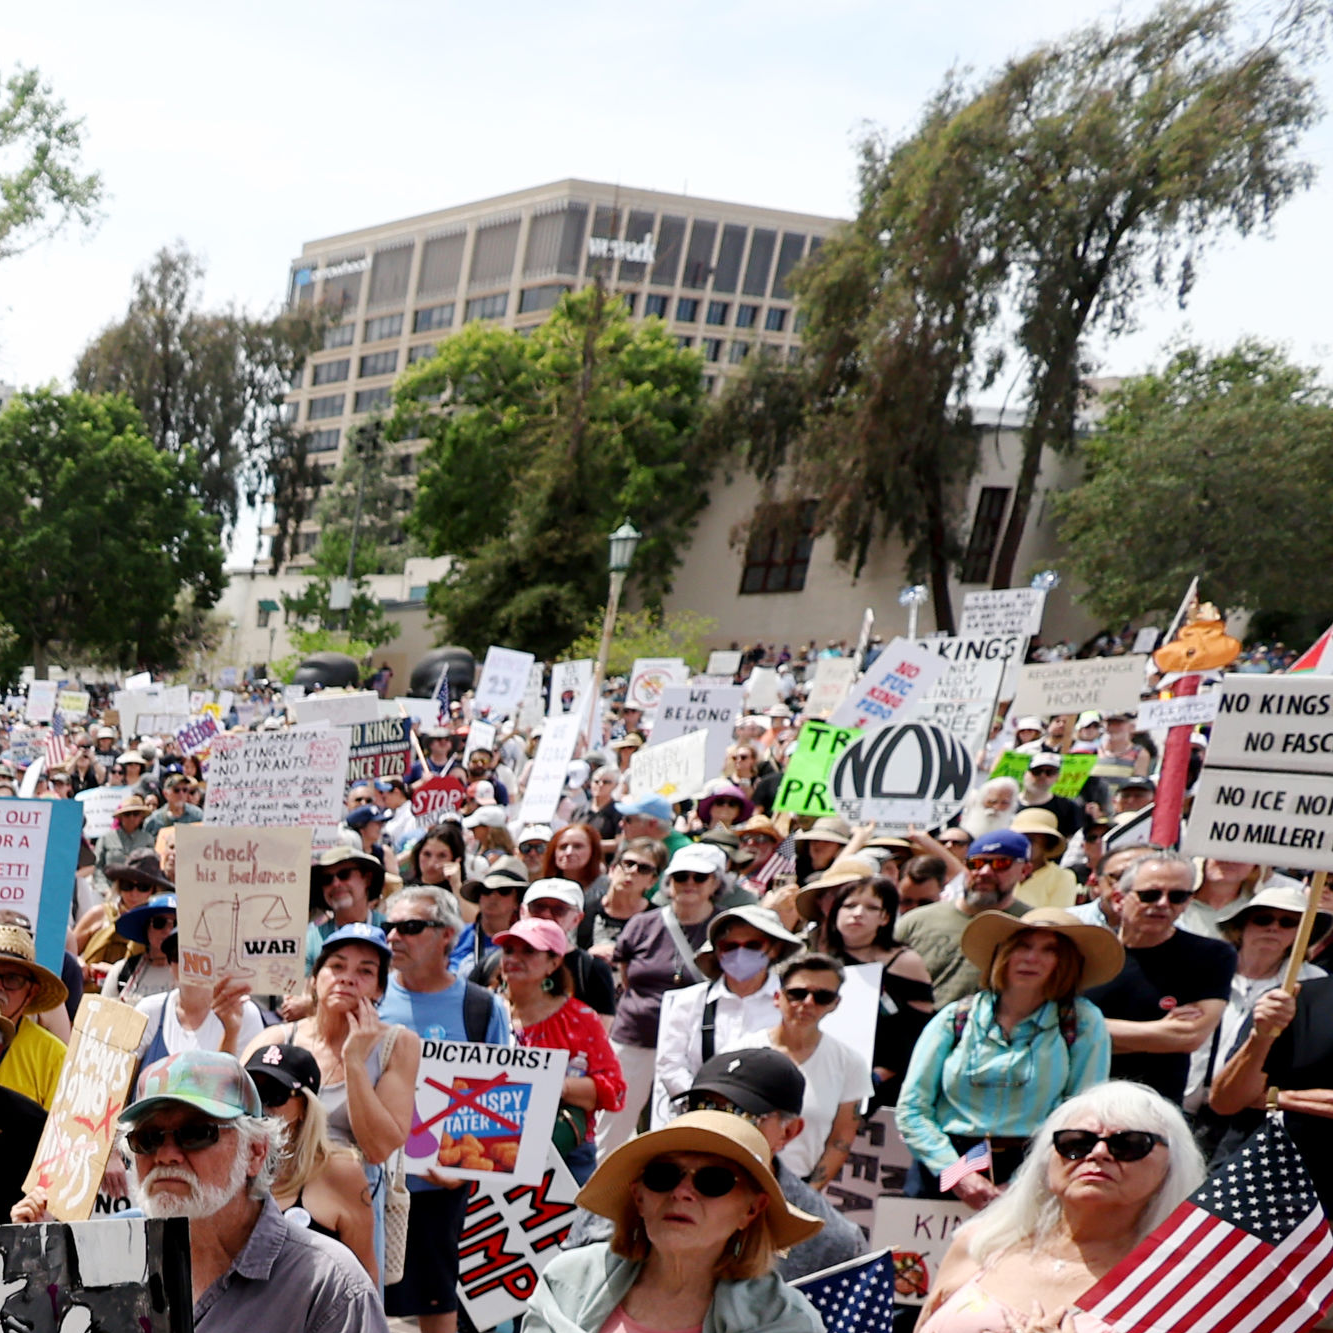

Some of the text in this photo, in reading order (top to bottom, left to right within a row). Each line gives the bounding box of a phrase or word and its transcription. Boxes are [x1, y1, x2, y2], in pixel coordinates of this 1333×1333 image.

[689, 689, 711, 704] WE
[1218, 693, 1331, 716] NO KINGS
[664, 709, 732, 723] BELONG
[363, 717, 403, 743] KINGS
[1244, 731, 1275, 752] NO
[375, 750, 404, 775] 1776
[833, 722, 973, 801] NOW
[412, 789, 462, 813] STOP
[1216, 785, 1245, 807] NO
[1251, 790, 1287, 812] ICE
[6, 810, 42, 825] OUT
[18, 834, 30, 849] A
[1209, 820, 1326, 850] NO MILLER!
[202, 839, 259, 863] check
[195, 860, 298, 886] his balance
[244, 939, 297, 955] WAR
[182, 950, 213, 977] NO
[261, 1045, 284, 1066] LA
[421, 1040, 553, 1072] DICTATORS!
[456, 1089, 524, 1116] ISPY
[443, 1114, 490, 1134] TATER
[94, 1193, 132, 1215] NO
